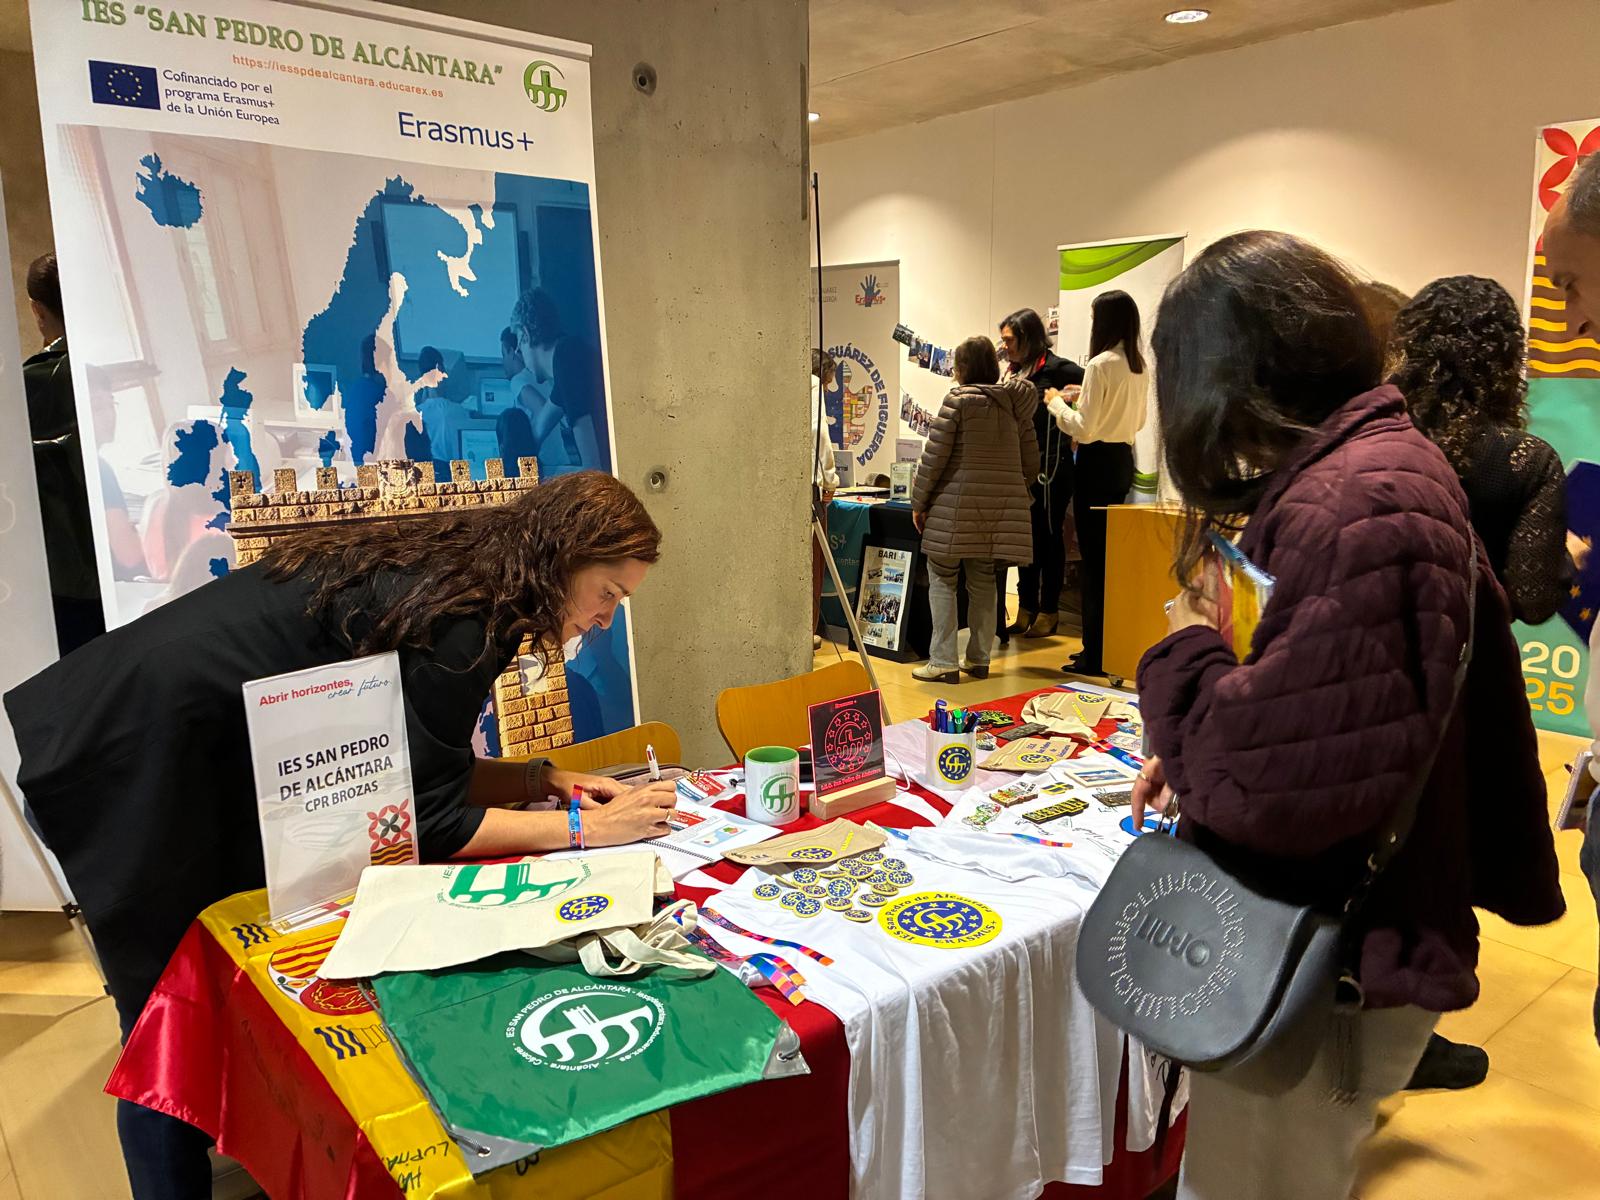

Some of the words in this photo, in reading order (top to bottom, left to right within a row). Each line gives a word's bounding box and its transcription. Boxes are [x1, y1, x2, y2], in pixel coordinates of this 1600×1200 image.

[82, 0, 127, 25] IES
[214, 17, 304, 53] PEDRO
[310, 33, 345, 59] DE
[163, 70, 238, 89] Cofinanciado
[240, 81, 260, 94] por
[263, 84, 273, 94] el
[232, 54, 444, 98] https://iesspdealcantara.educarex.es
[165, 88, 220, 103] programa
[223, 92, 275, 109] Erasmus+
[167, 103, 181, 113] de
[185, 104, 194, 115] la
[198, 106, 232, 118] Unión
[236, 109, 280, 125] Europea
[398, 111, 534, 151] Erasmus+
[871, 369, 885, 393] DE
[857, 393, 889, 466] FIGUEROA
[878, 550, 897, 561] BARI
[1521, 641, 1580, 679] 20
[259, 691, 289, 706] Abrir
[291, 679, 354, 698] horizontes,
[328, 687, 355, 700] crear
[357, 675, 390, 697] futuro
[1525, 677, 1575, 715] 25
[278, 757, 302, 777] IES
[306, 747, 337, 769] SAN
[341, 733, 390, 759] PEDRO
[280, 781, 302, 801] DE
[305, 755, 393, 793] ALCÁNTARA
[305, 795, 330, 812] CPR
[332, 780, 379, 805] BROZAS
[885, 900, 912, 916] Pedro
[887, 917, 897, 930] San
[554, 988, 568, 996] DE
[571, 984, 632, 994] ALCÁNTARA
[522, 993, 553, 1014] PEDRO
[506, 1026, 515, 1038] IES
[510, 1012, 524, 1028] SAN
